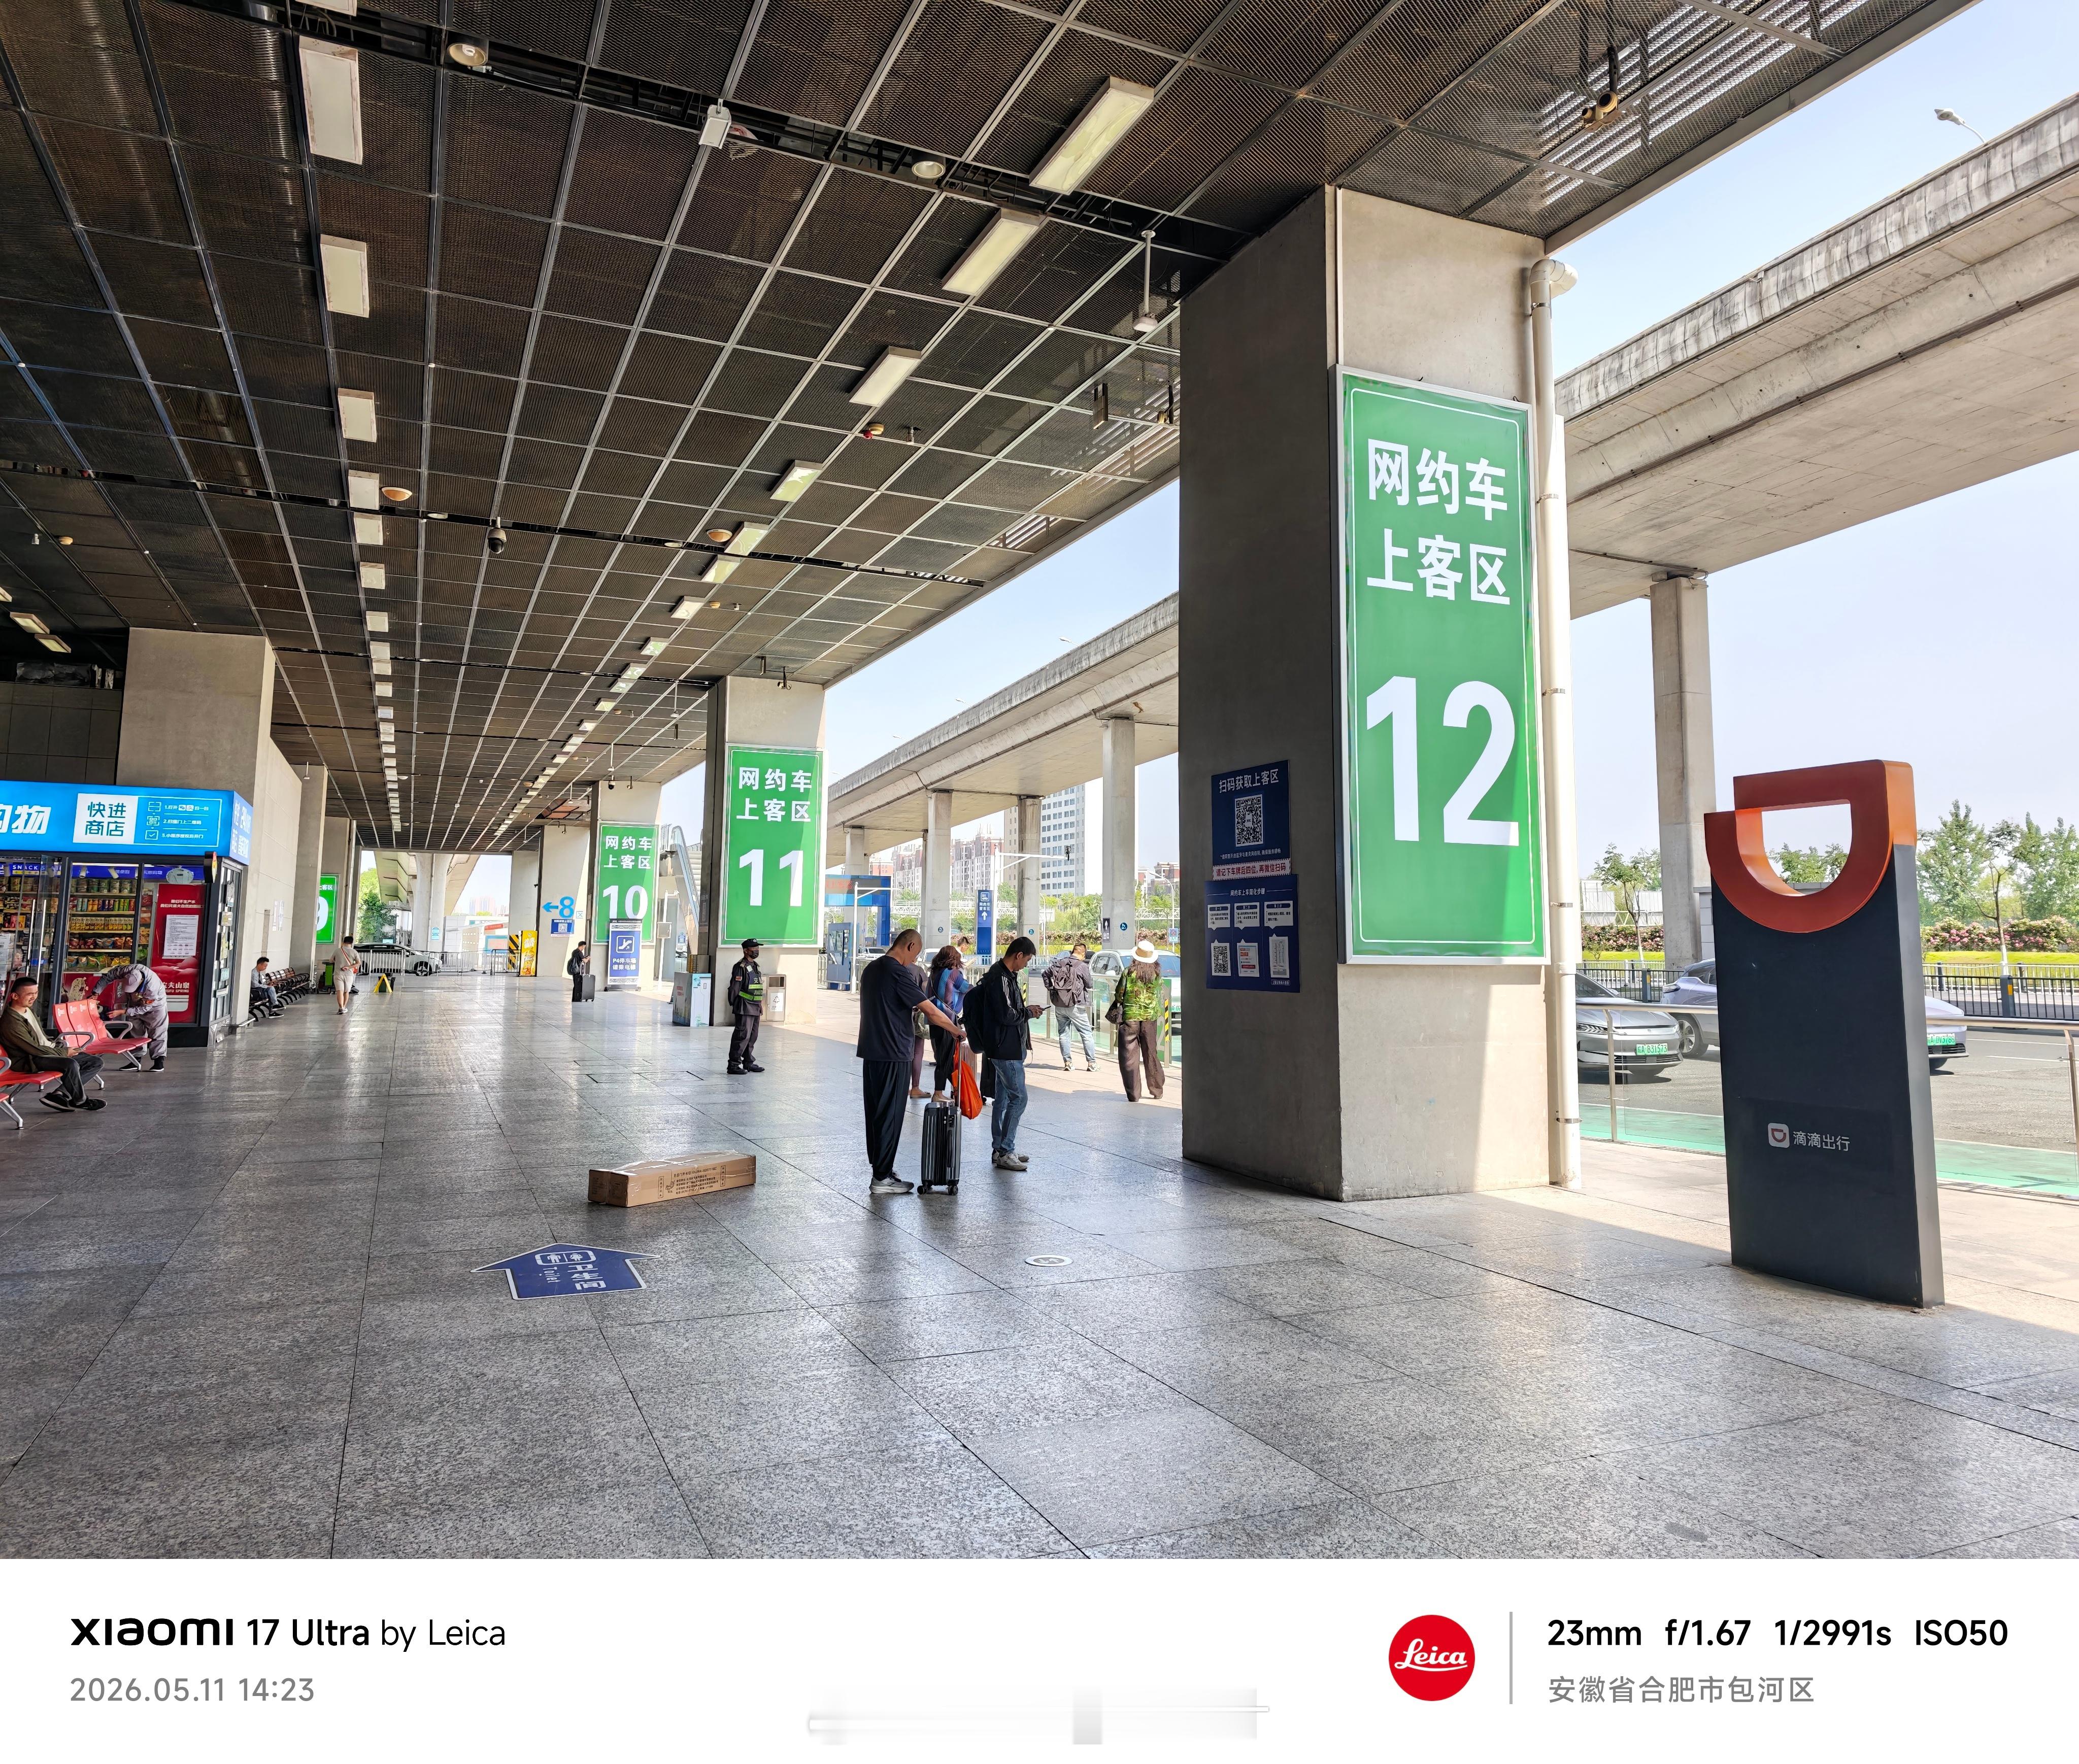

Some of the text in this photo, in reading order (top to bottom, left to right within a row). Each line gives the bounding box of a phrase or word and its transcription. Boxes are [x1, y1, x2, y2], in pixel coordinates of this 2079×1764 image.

[1367, 438, 1508, 521] 网约车
[1367, 527, 1510, 605] 上客区
[1366, 675, 1519, 847] 12
[739, 767, 812, 793] 网约车
[1219, 768, 1279, 793] 扫码获取上客区
[87, 801, 126, 819] 快进
[736, 798, 811, 822] 上客区
[85, 820, 125, 837] 商店
[605, 835, 652, 851] 网约车
[603, 854, 651, 869] 上客区
[739, 849, 803, 907] 11
[559, 896, 574, 919] 8
[602, 885, 648, 919] 10
[1793, 1131, 1851, 1151] 滴滴出行
[543, 1267, 561, 1283] Toilet
[567, 1264, 607, 1290] 卫生间
